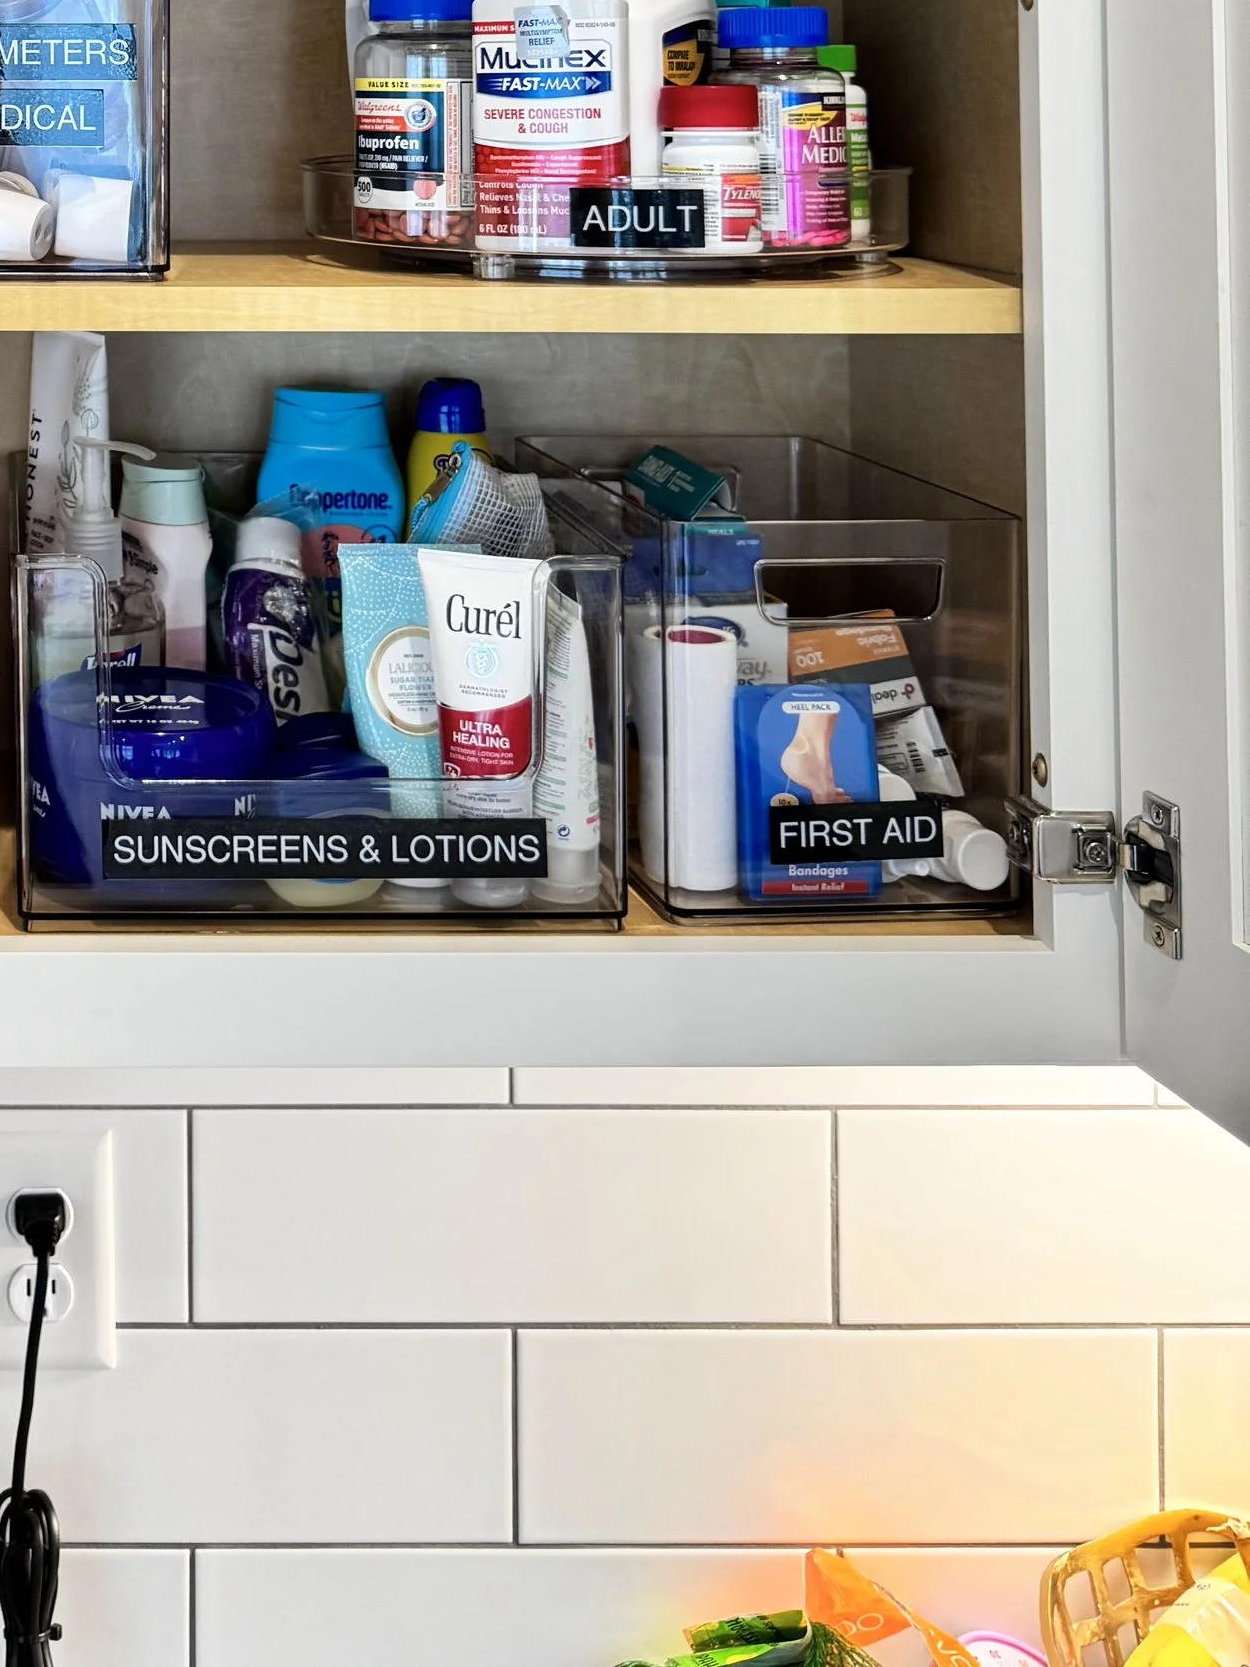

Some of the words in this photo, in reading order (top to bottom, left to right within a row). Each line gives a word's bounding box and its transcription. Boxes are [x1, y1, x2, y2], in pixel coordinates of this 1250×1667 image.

[528, 38, 556, 47] RELIEF
[502, 77, 581, 91] FAST-MAX
[484, 108, 525, 120] SEVERE
[528, 108, 602, 120] CONGESTION
[517, 123, 526, 133] &
[529, 122, 569, 134] COUGH
[358, 134, 420, 151] Ibuprofen
[357, 181, 371, 193] 500
[479, 193, 518, 201] Relieves
[479, 205, 502, 214] Thins
[503, 206, 510, 214] &
[582, 205, 698, 233] ADULT
[446, 593, 522, 640] Curél
[796, 651, 825, 668] 100
[459, 684, 509, 694] DERMATOLOGIST
[461, 690, 507, 699] RECOMMENDED
[96, 694, 206, 705] NIVEA
[459, 720, 503, 736] ULTRA
[452, 731, 511, 750] HEALING
[477, 749, 500, 758] LOTION
[500, 751, 513, 759] FOR
[481, 757, 499, 765] TIGHT
[100, 802, 173, 821] NIVEA
[779, 818, 874, 849] FIRST
[882, 815, 938, 845] AID
[113, 835, 349, 864] SUNSCREENS
[359, 834, 381, 863] &
[390, 833, 541, 864] LOTIONS
[788, 864, 849, 879] Bandages
[791, 883, 819, 892] Instant
[820, 882, 845, 891] Relief
